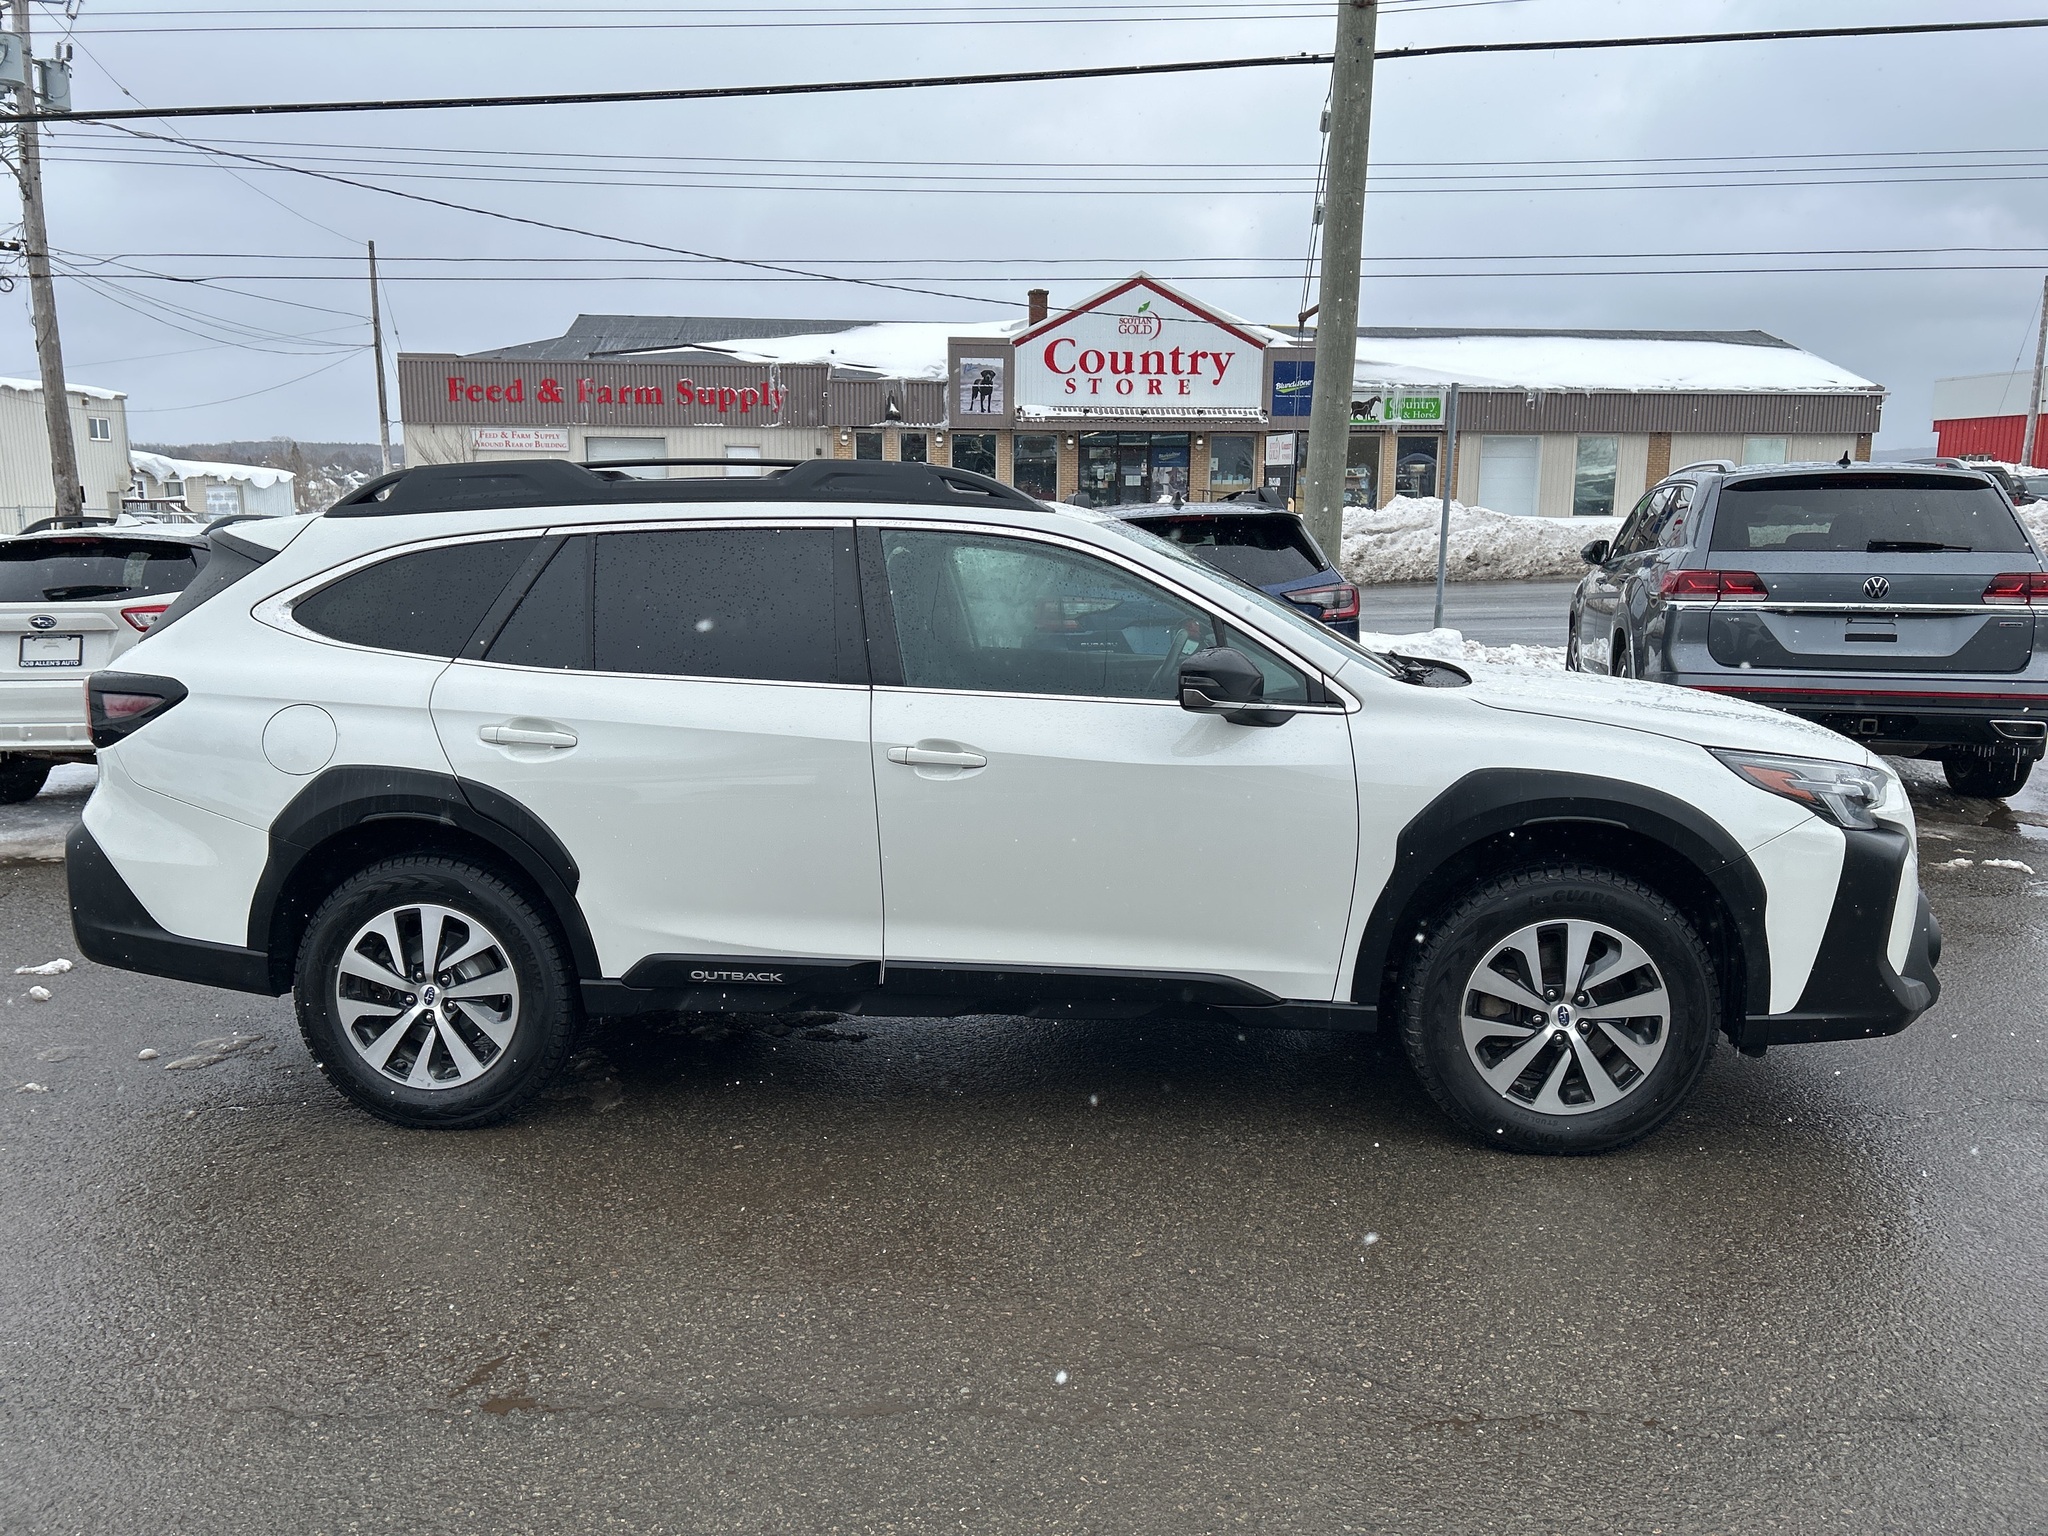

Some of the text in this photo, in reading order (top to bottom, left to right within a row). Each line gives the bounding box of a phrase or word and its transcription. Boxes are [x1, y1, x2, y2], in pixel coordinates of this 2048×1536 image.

[1118, 317, 1152, 325] SCOTIAN
[1118, 324, 1153, 335] GOLD
[1043, 338, 1236, 386] Country
[1064, 378, 1191, 395] STORE
[446, 377, 790, 413] Feed & Farm Supply
[1403, 411, 1410, 419] &
[1412, 410, 1437, 418] Horse
[479, 430, 560, 440] FEED & FARM SUPPLY
[505, 440, 524, 448] REAR
[535, 440, 567, 448] BUILDING
[690, 970, 783, 982] OUTBACK
